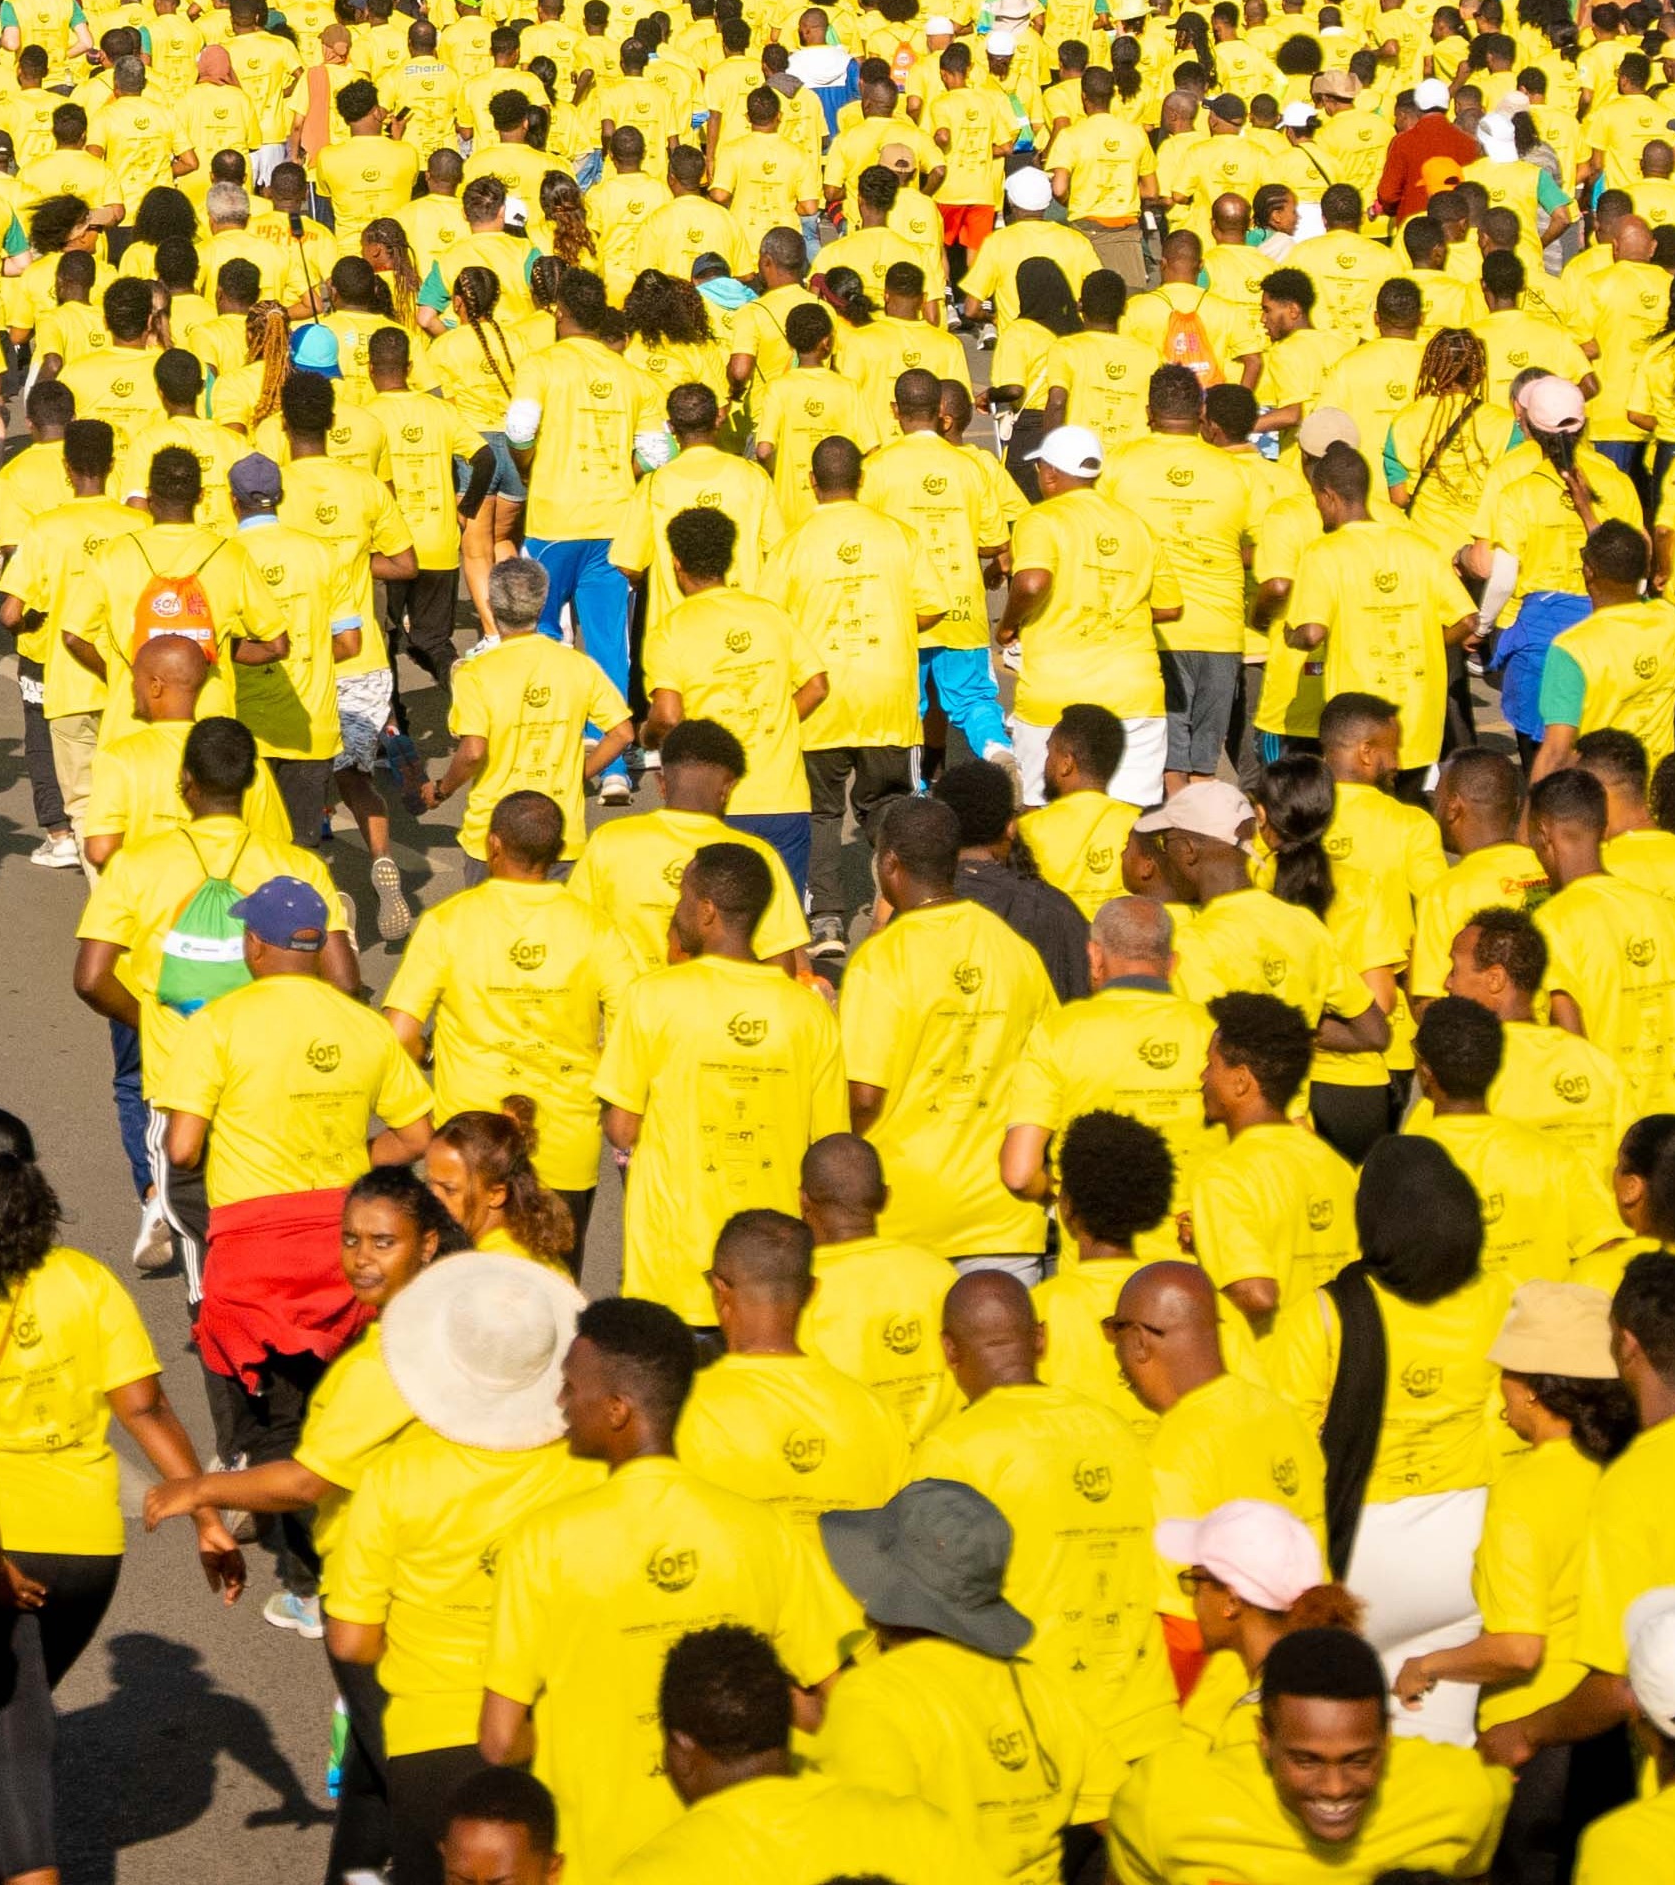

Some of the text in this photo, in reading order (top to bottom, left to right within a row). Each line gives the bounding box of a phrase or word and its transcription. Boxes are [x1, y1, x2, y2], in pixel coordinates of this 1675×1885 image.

[725, 633, 751, 646] SOFI
[1633, 656, 1658, 673] SOFI
[523, 687, 551, 702] SOFI
[1086, 848, 1113, 866] SOFI
[509, 945, 547, 961] SOFI
[1625, 941, 1656, 960] SOFI
[954, 967, 982, 985] SOFI
[727, 1019, 768, 1036] SOFI
[306, 1044, 341, 1065] SOFI
[1138, 1041, 1179, 1060] SOFI
[1554, 1073, 1591, 1095] SOFI
[883, 1320, 921, 1347] SOFI
[1401, 1367, 1443, 1387] SOFI
[783, 1438, 825, 1459] SOFI
[1073, 1466, 1113, 1489] SOFI
[647, 1549, 697, 1583] SOFI
